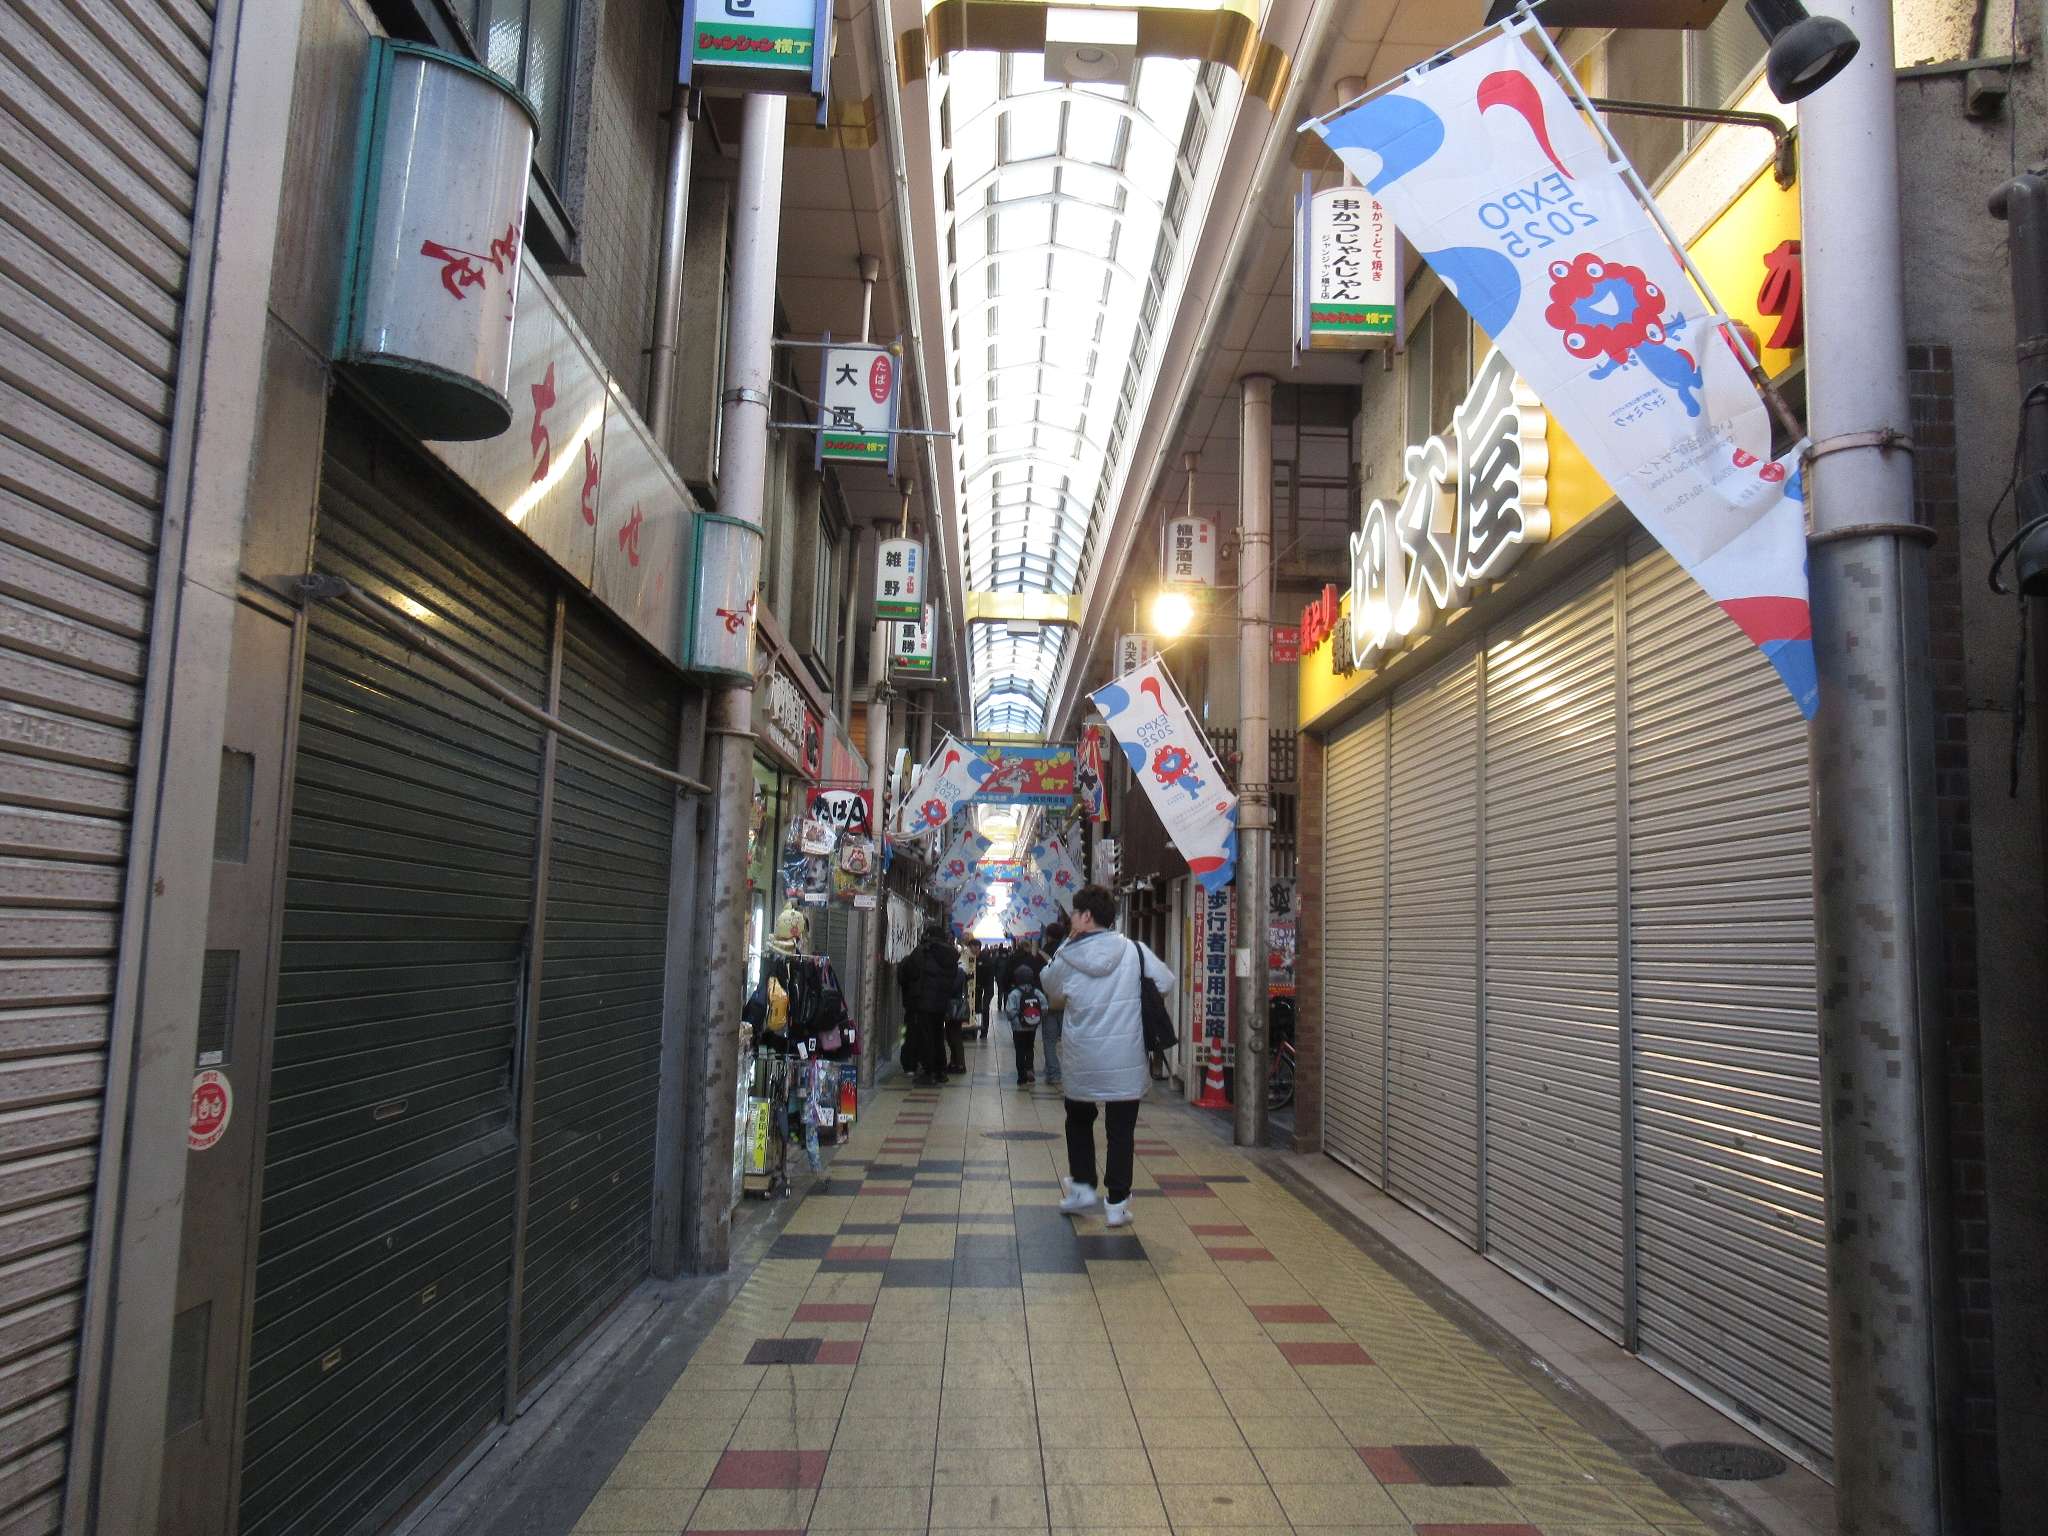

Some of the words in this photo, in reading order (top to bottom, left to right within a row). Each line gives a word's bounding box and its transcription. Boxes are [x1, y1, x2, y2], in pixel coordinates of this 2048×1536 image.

[1332, 199, 1361, 300] 串かつじゃんじゃん
[1371, 200, 1384, 281] 串かつ・どて焼き
[835, 363, 858, 428] 大西
[874, 360, 887, 399] たばこ
[1205, 890, 1227, 1037] 歩行者専用道路
